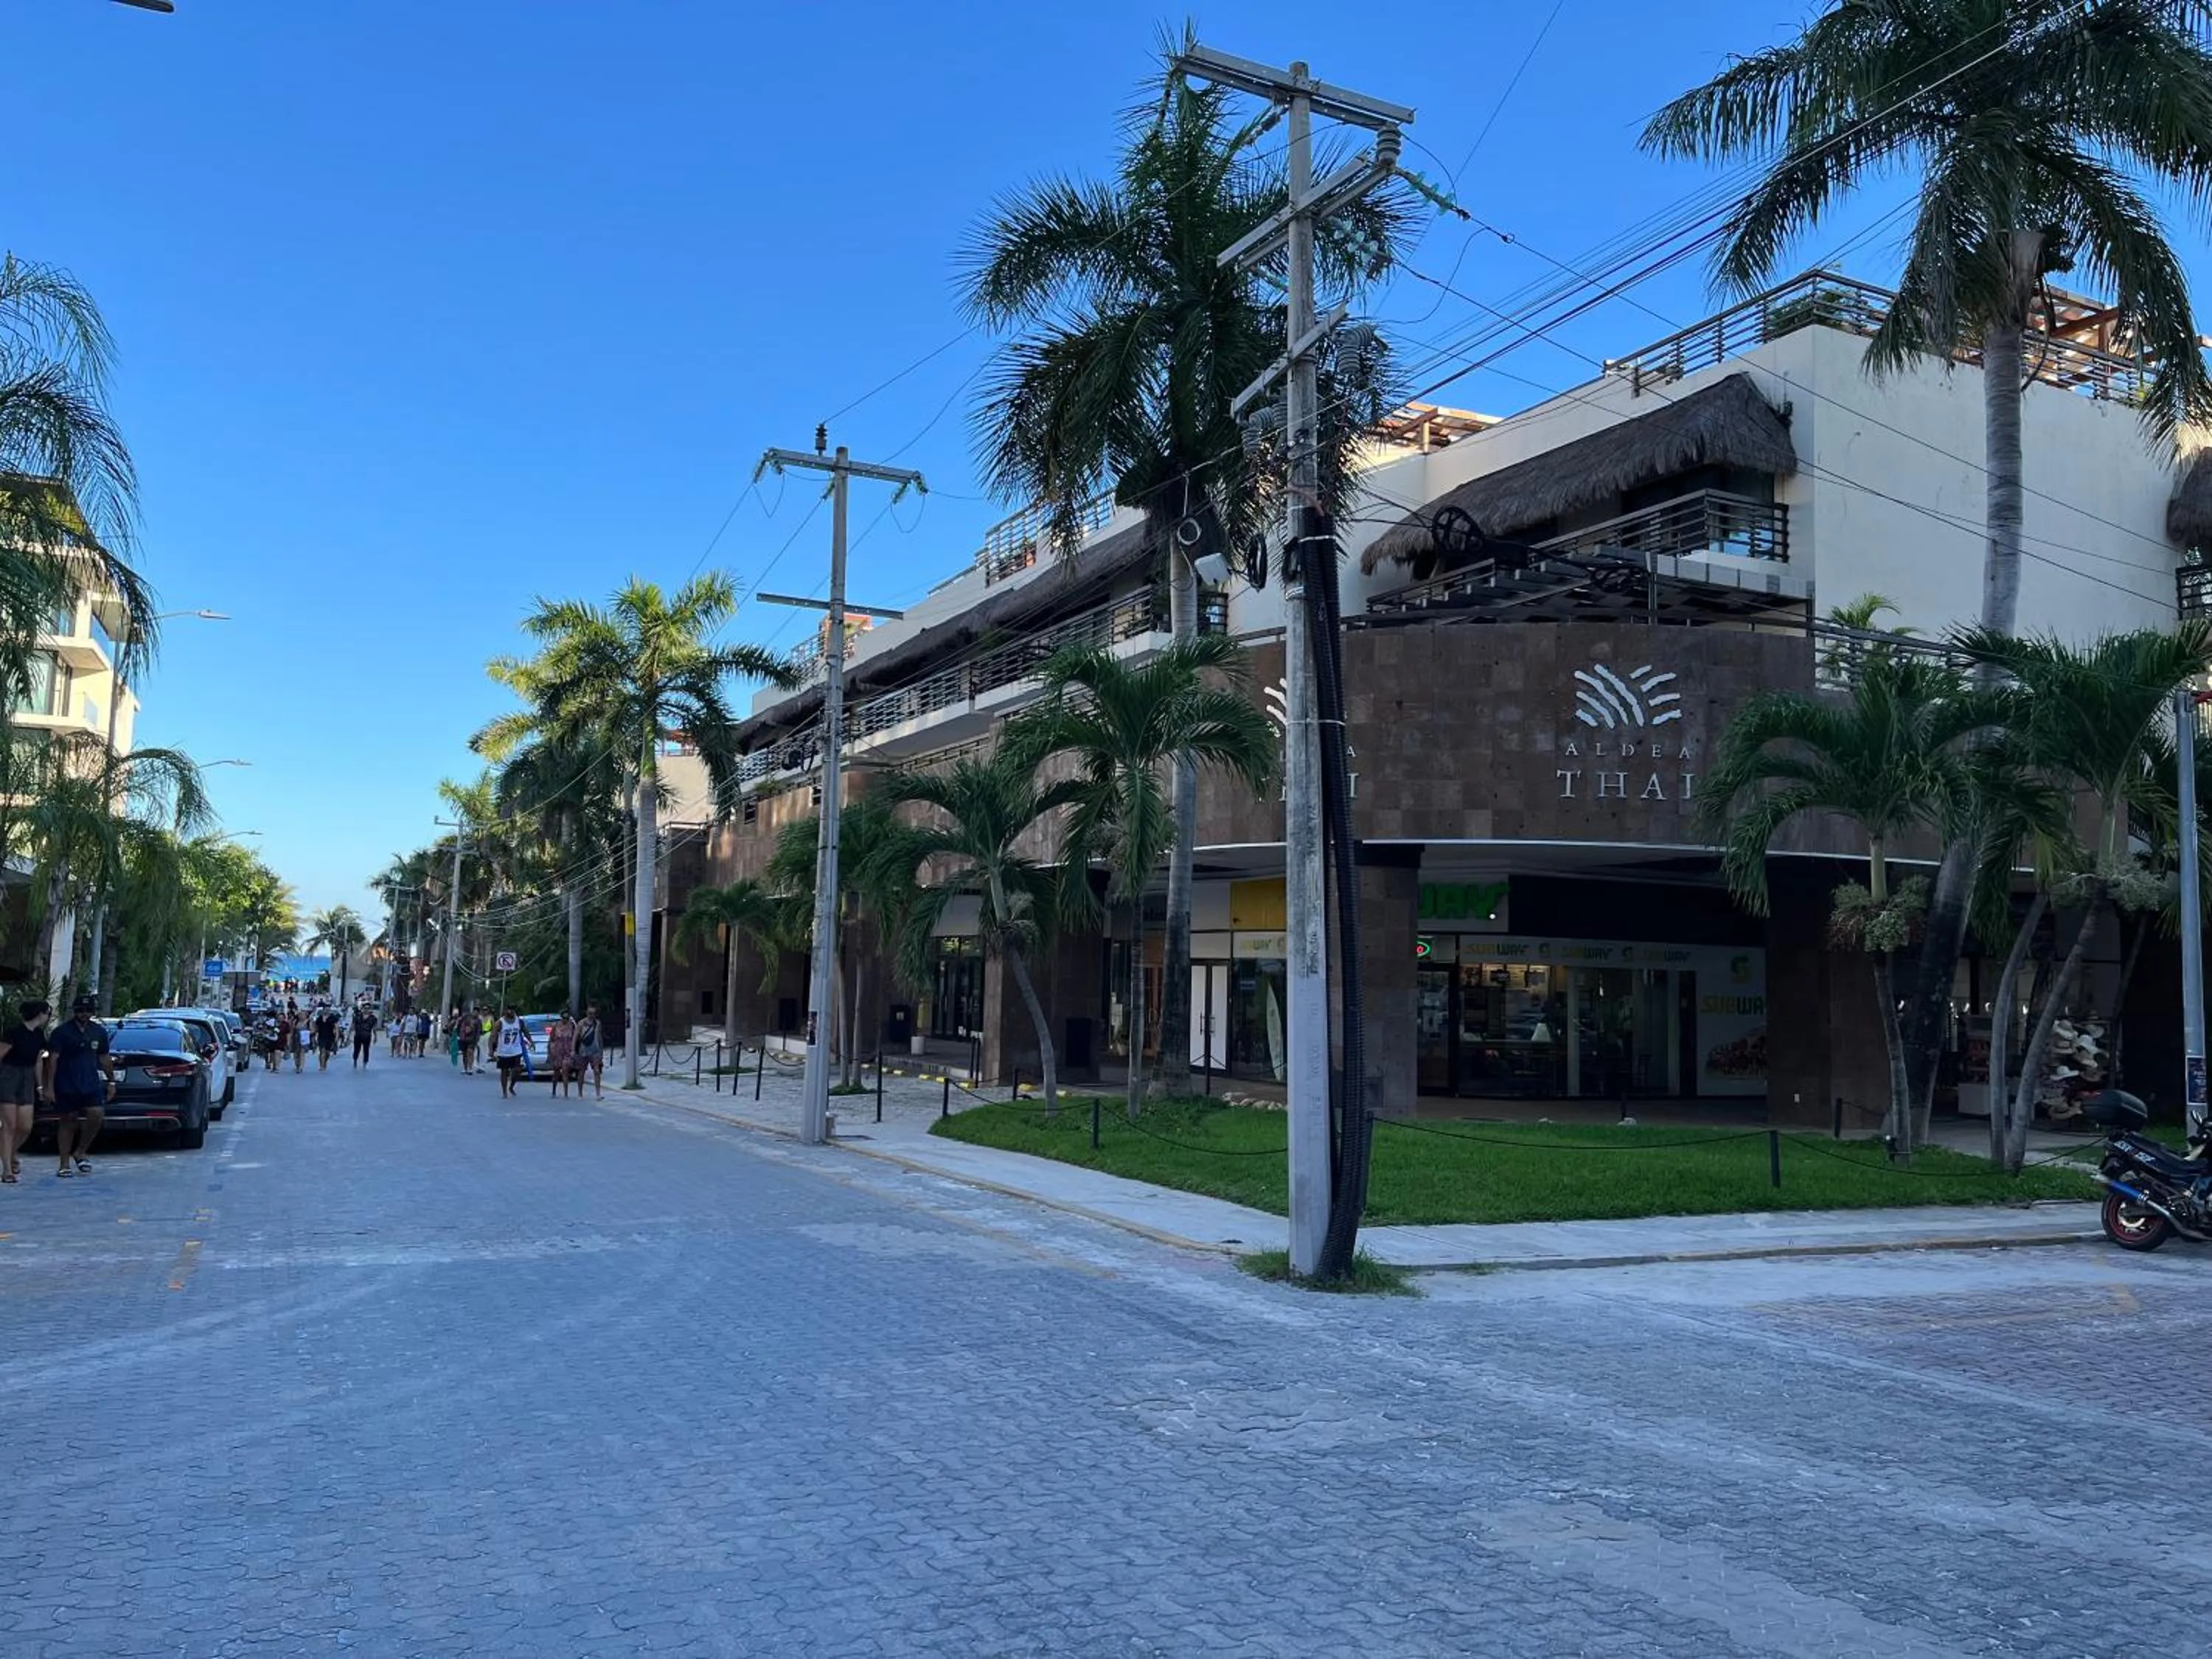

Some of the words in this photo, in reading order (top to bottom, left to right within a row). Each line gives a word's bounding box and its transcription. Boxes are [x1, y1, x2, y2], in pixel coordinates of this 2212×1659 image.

[1565, 742, 1691, 759] ALDEA
[1557, 769, 1694, 801] THAI
[1700, 991, 1764, 1015] SUBWA
